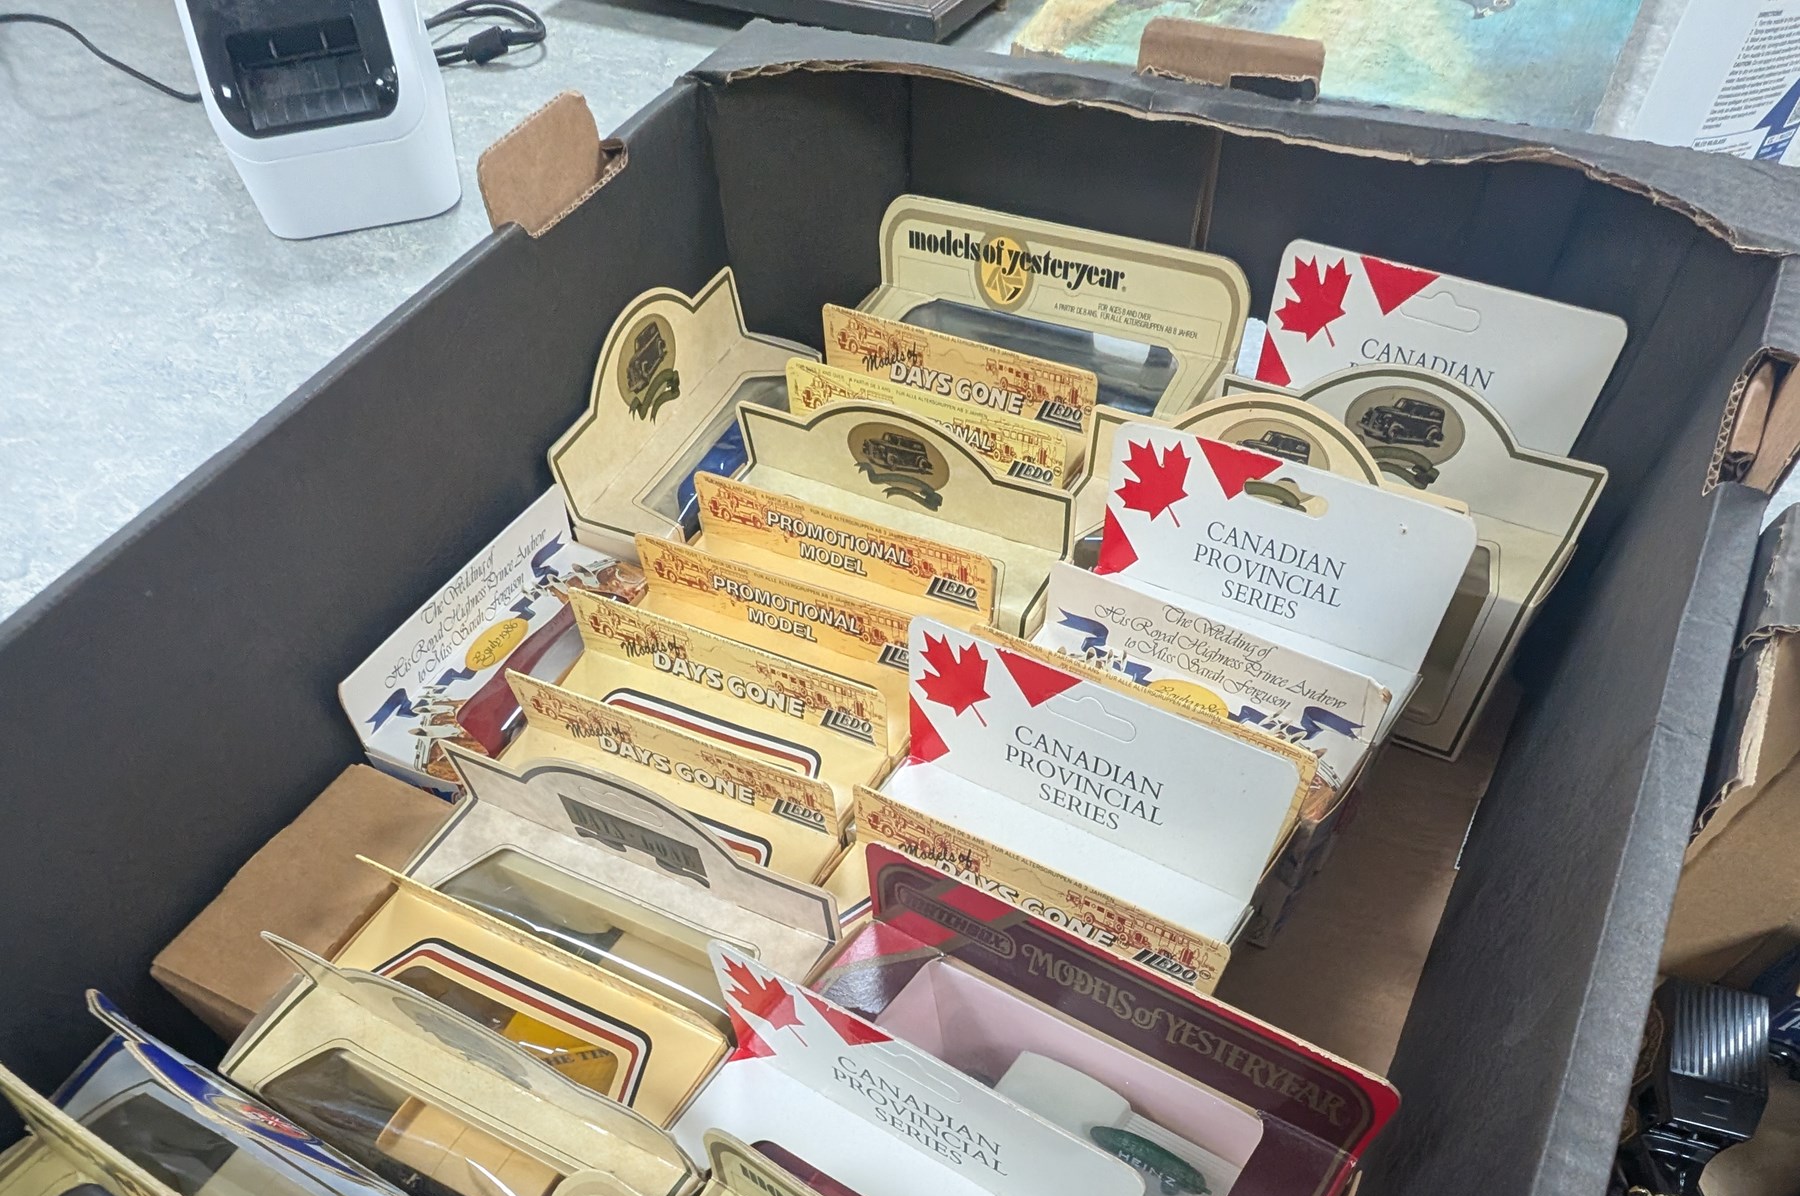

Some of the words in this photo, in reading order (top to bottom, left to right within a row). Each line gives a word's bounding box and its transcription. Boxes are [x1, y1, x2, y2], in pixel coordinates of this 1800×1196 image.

[908, 229, 981, 262] models
[982, 239, 1005, 266] of
[862, 349, 906, 372] Models
[889, 361, 953, 396] DAYS
[955, 377, 1026, 416] GONE
[766, 510, 912, 567] PROMOTIONAL
[799, 540, 868, 577] MODEL
[1207, 521, 1347, 581] CANADIAN
[712, 574, 863, 635] PROMOTIONAL
[1192, 544, 1343, 609] PROVINCIAL
[1221, 579, 1299, 620] SERIES
[620, 637, 667, 658] Models
[747, 606, 818, 642] MODEL
[1162, 604, 1193, 628] The
[1193, 616, 1259, 657] Wedding
[1257, 645, 1278, 662] of
[652, 651, 724, 692] DAYS
[727, 673, 805, 719] GONE
[1095, 604, 1128, 627] His
[1130, 616, 1179, 650] Royal
[1177, 634, 1244, 672] Highness
[1245, 656, 1288, 688] Prince
[1286, 680, 1348, 709] Andrew
[1124, 637, 1137, 649] to
[1137, 640, 1177, 665] Miss
[1177, 653, 1225, 684] Sarah
[1222, 677, 1292, 710] Ferguson
[566, 723, 611, 739] Models
[599, 735, 672, 775] DAYS
[675, 761, 755, 806] GONE
[1005, 744, 1165, 827] PROVINCIAL
[1014, 725, 1165, 800] CANADIAN
[1038, 783, 1120, 831] SERIES
[898, 842, 957, 863] Models
[935, 860, 1019, 905] DAYS
[1021, 897, 1118, 948] GONE
[1022, 944, 1135, 1022] MODELS
[1160, 1010, 1347, 1126] YESTERYEAR
[831, 1067, 1008, 1177] PROVINCIAL
[837, 1056, 1001, 1156] CANADIAN
[873, 1106, 963, 1166] SERIES
[1118, 1149, 1176, 1187] HEINZ
